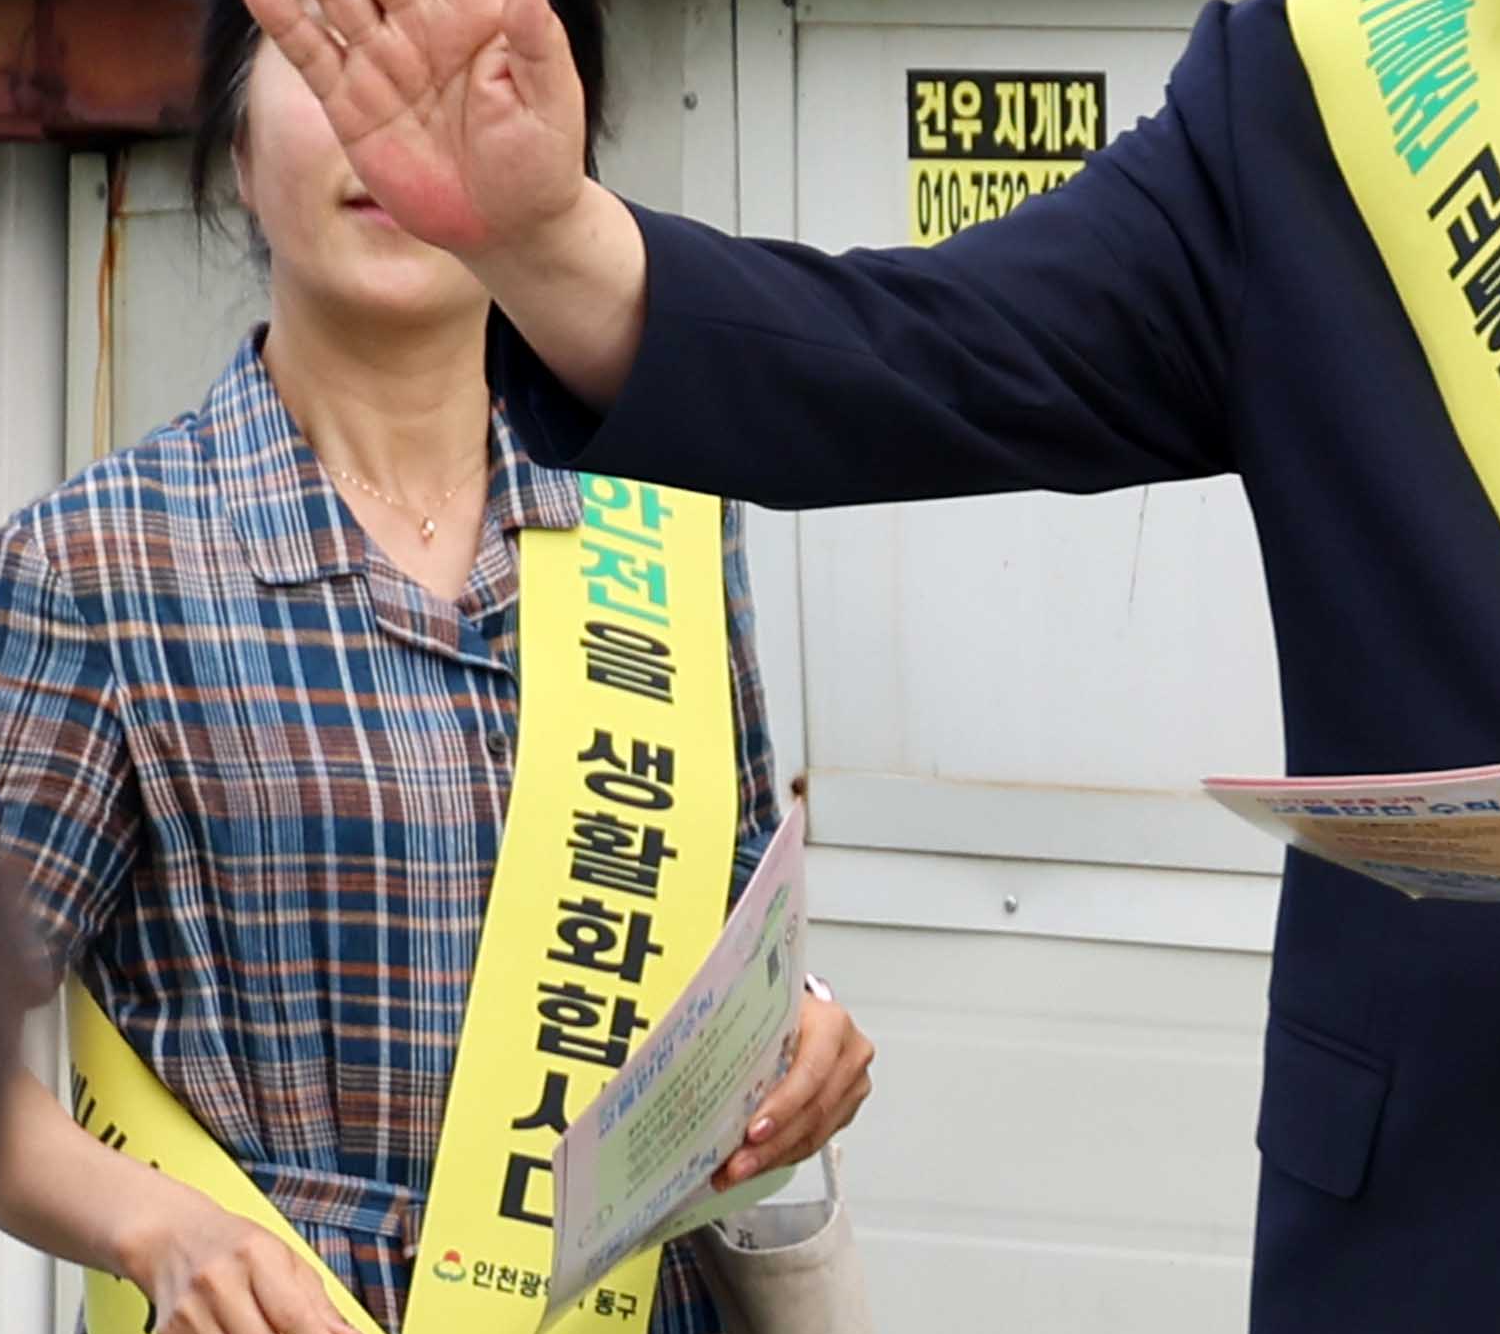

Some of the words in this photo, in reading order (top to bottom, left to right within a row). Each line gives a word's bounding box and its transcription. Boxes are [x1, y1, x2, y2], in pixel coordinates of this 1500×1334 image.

[915, 80, 983, 152] 건우
[993, 80, 1099, 152] 지게차
[594, 1287, 638, 1321] 동구
